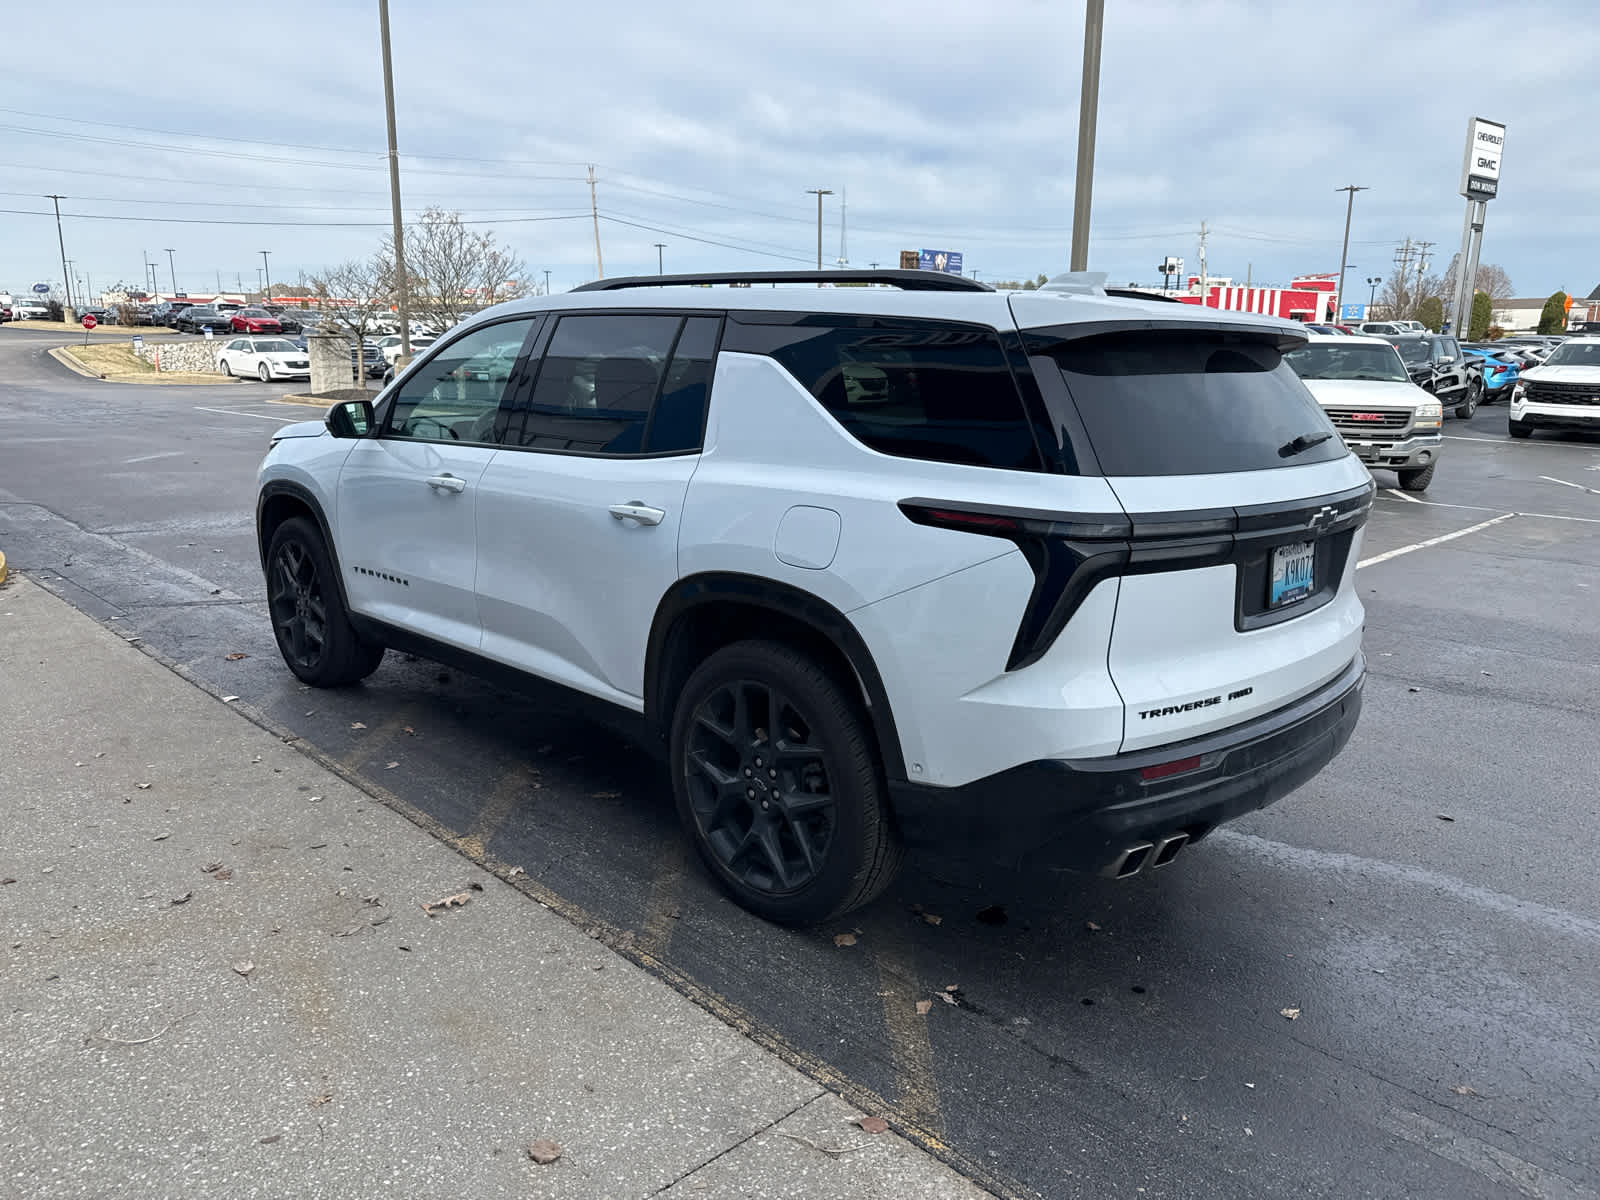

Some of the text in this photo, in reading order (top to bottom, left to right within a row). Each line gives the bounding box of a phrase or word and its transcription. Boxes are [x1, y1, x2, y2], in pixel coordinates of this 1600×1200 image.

[1477, 131, 1503, 145] CHEVROLET
[1477, 157, 1497, 170] GMC
[82, 318, 97, 326] STOP
[353, 566, 409, 586] TRAVERSE
[1138, 686, 1253, 719] TRAVERSE AWD
